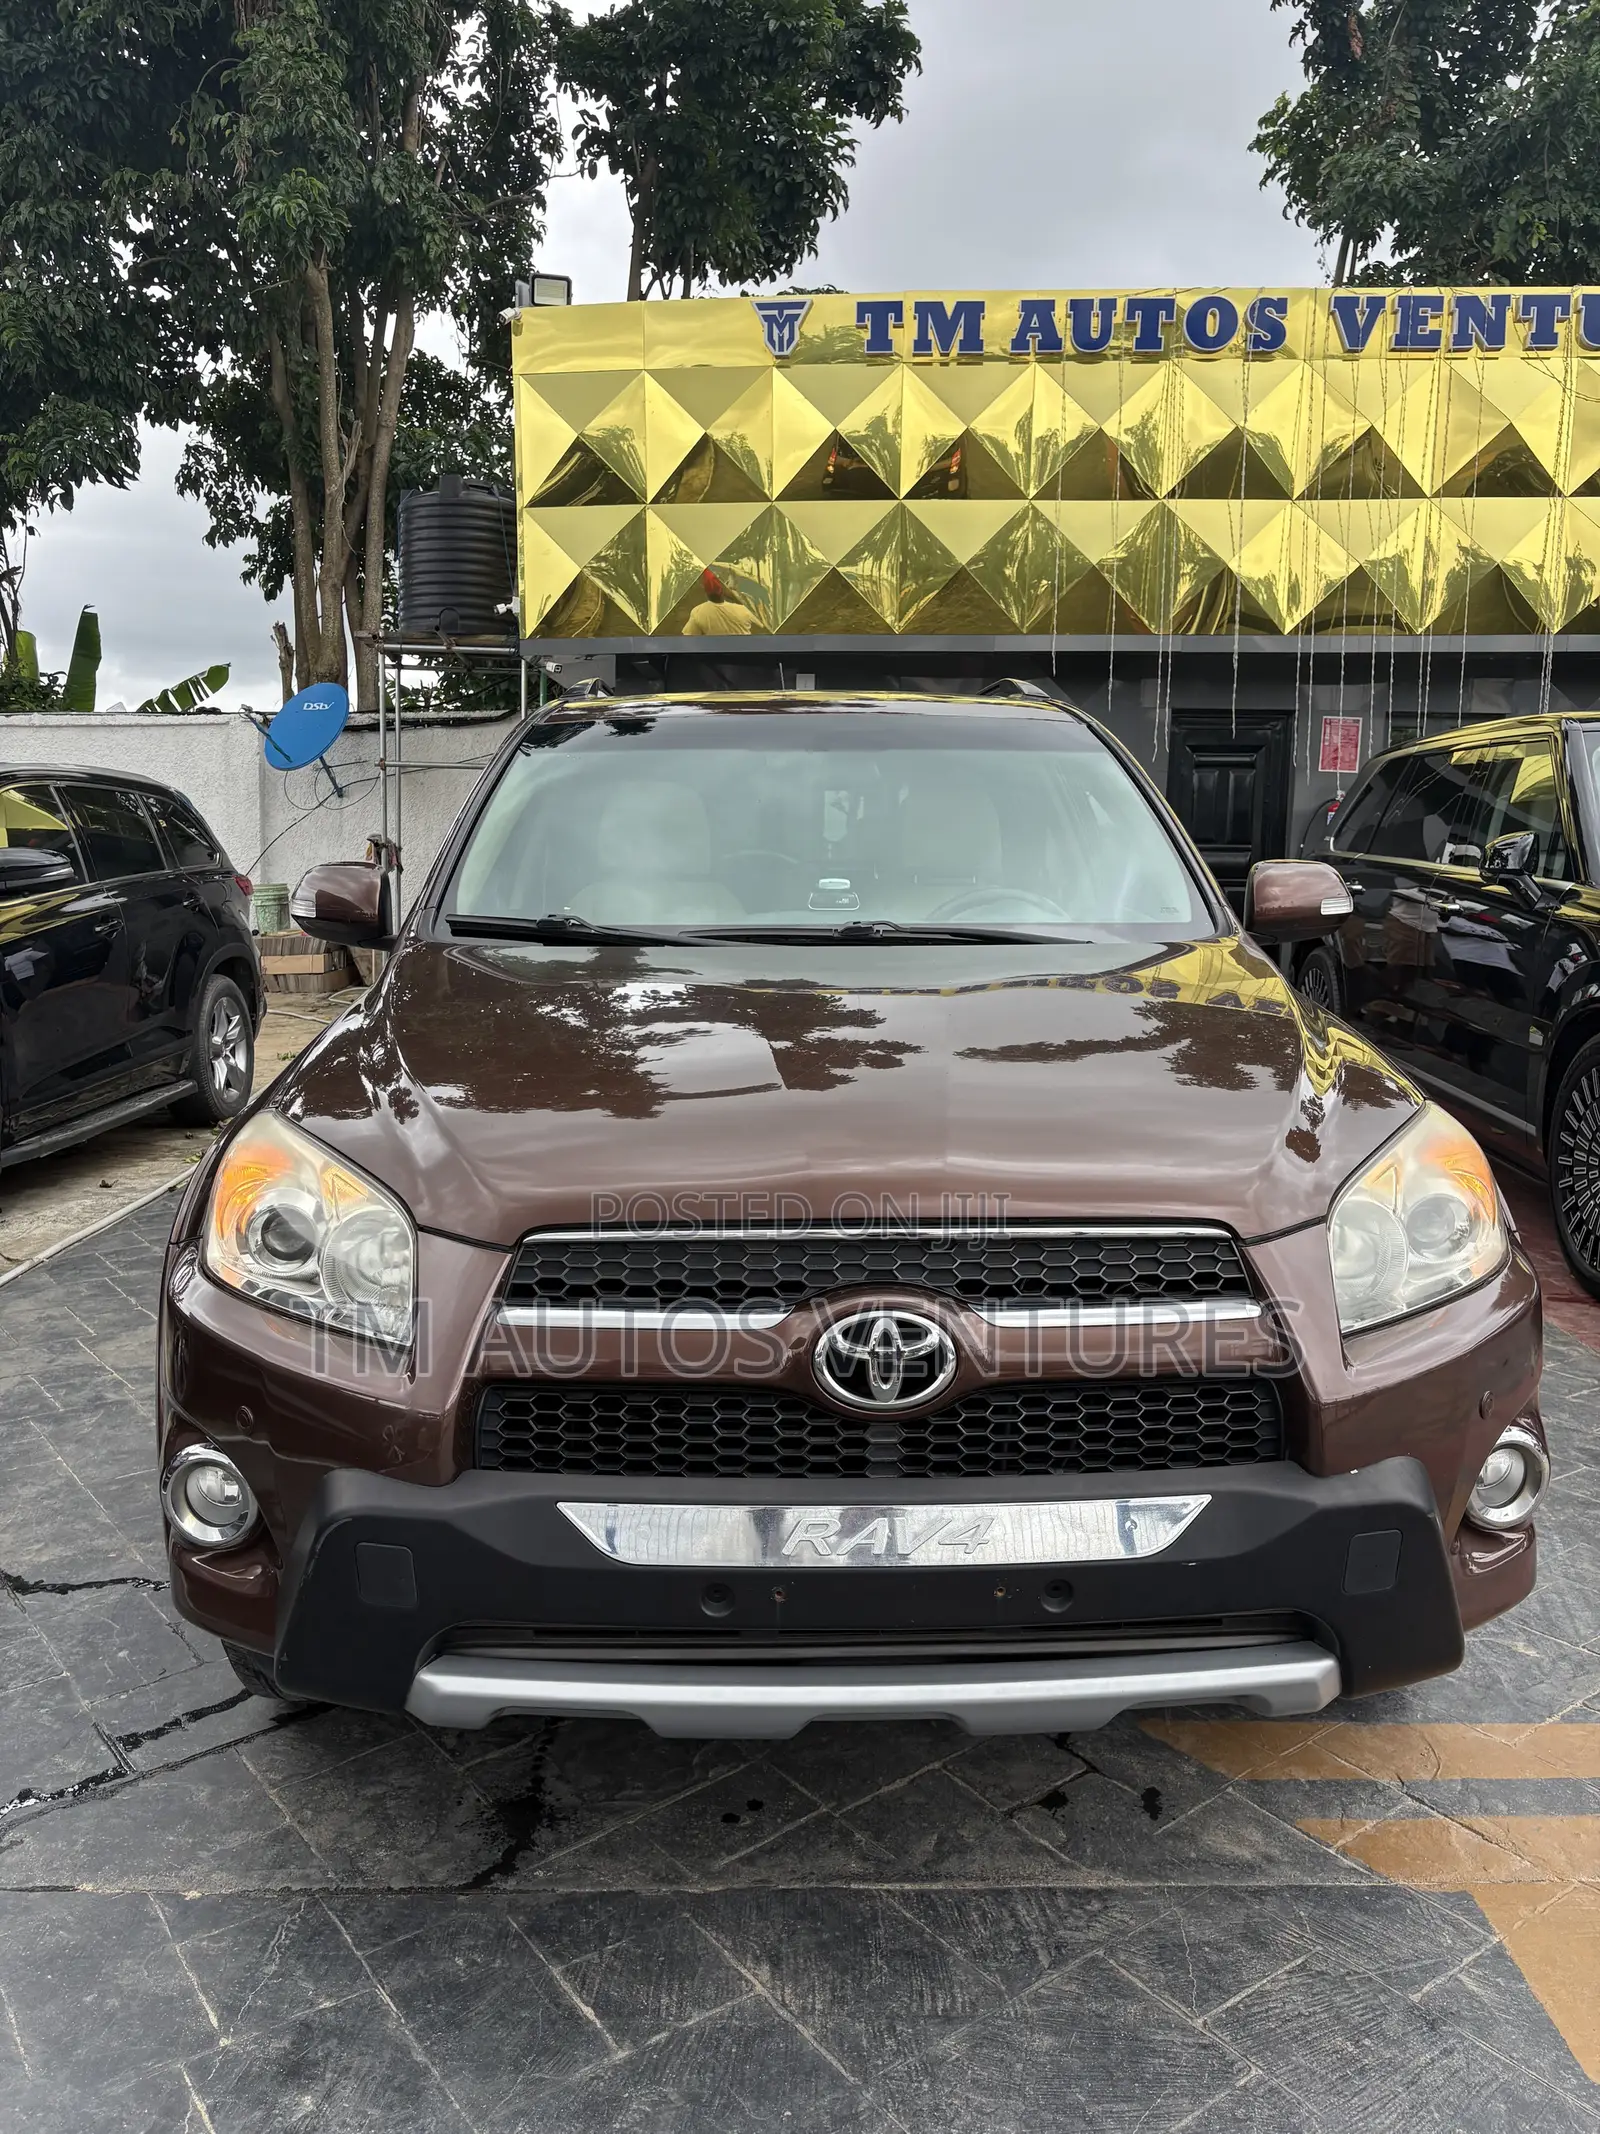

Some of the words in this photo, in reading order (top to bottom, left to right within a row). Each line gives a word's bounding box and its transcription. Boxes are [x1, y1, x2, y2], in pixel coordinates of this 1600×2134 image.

[855, 299, 986, 356] TM
[1009, 296, 1289, 355] AUTOS
[781, 1515, 997, 1557] RAV4
